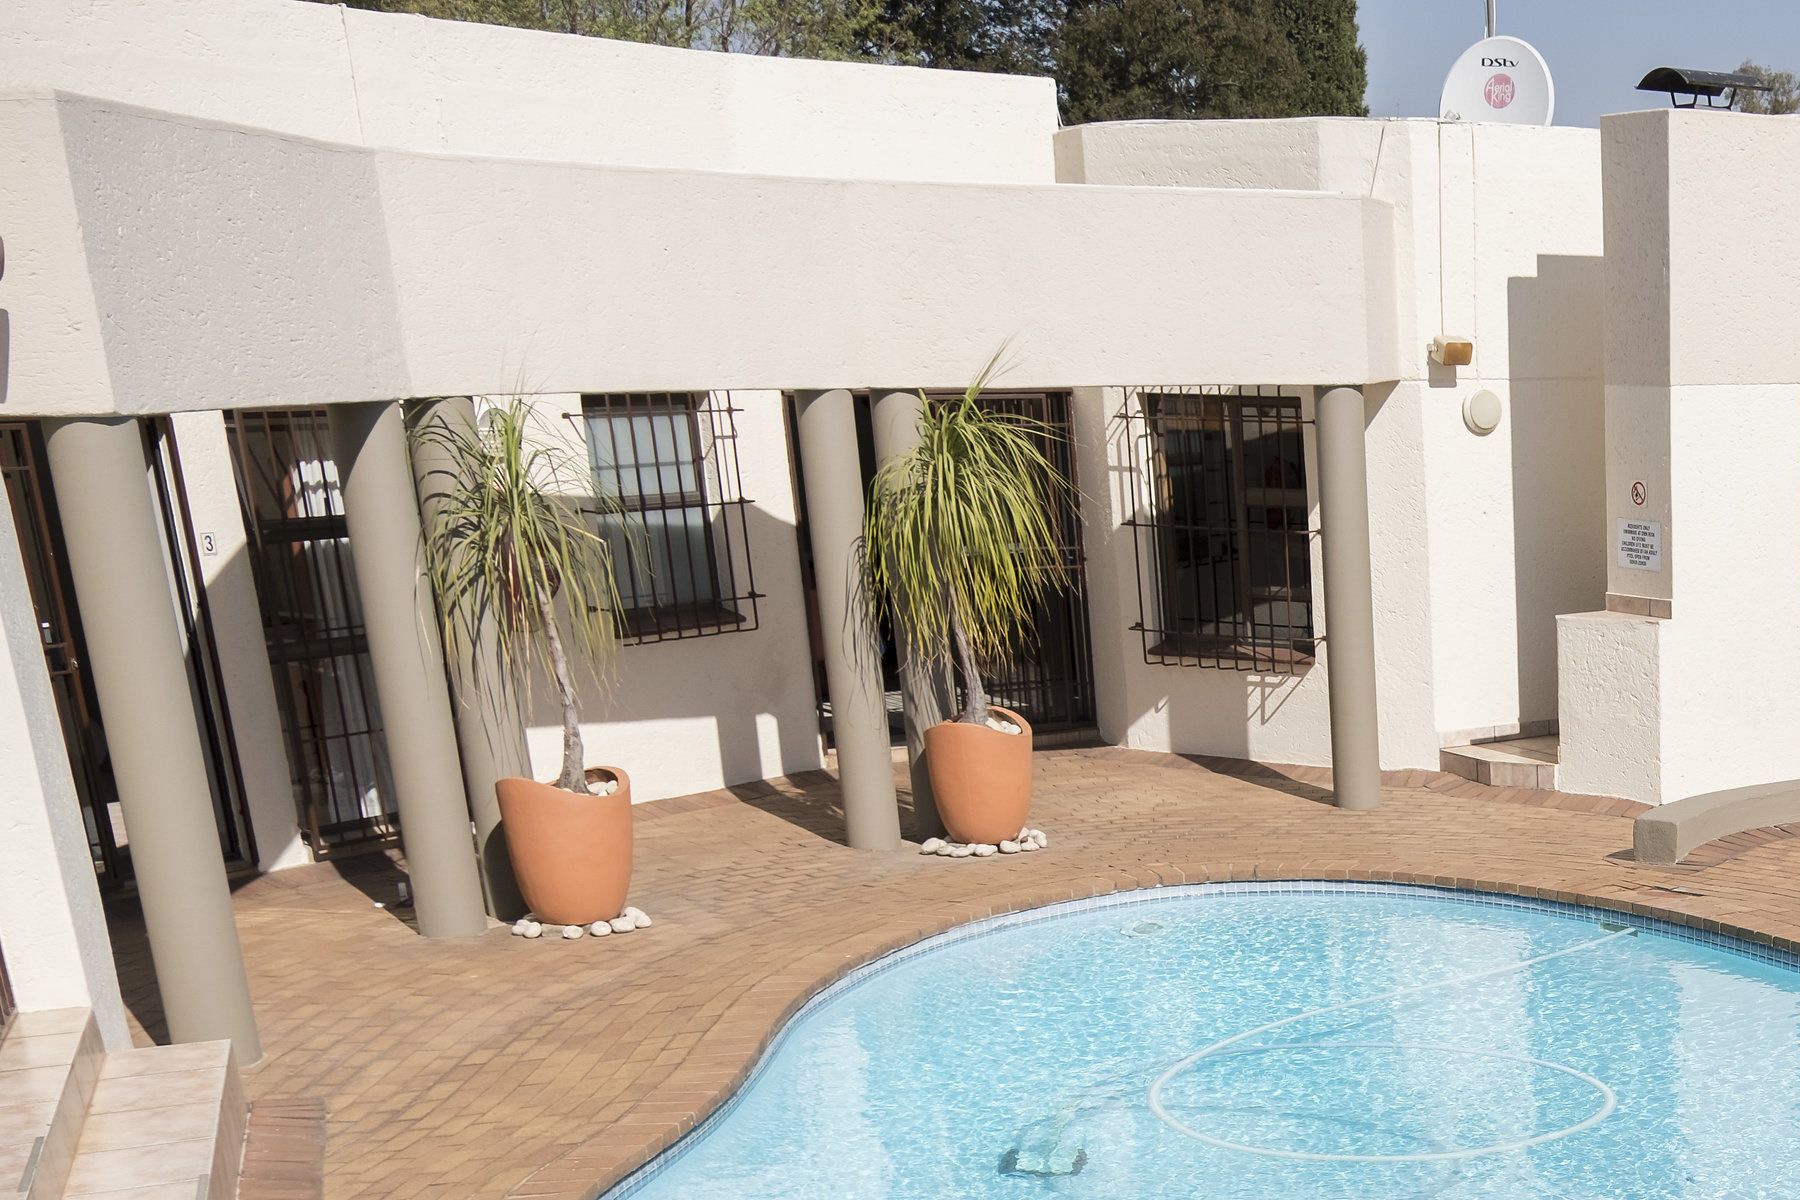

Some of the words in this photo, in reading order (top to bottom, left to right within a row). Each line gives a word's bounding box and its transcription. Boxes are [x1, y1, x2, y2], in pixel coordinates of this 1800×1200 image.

[1481, 57, 1519, 67] DStv
[1486, 77, 1513, 93] Aerial
[1491, 91, 1511, 107] King
[204, 535, 214, 552] 3
